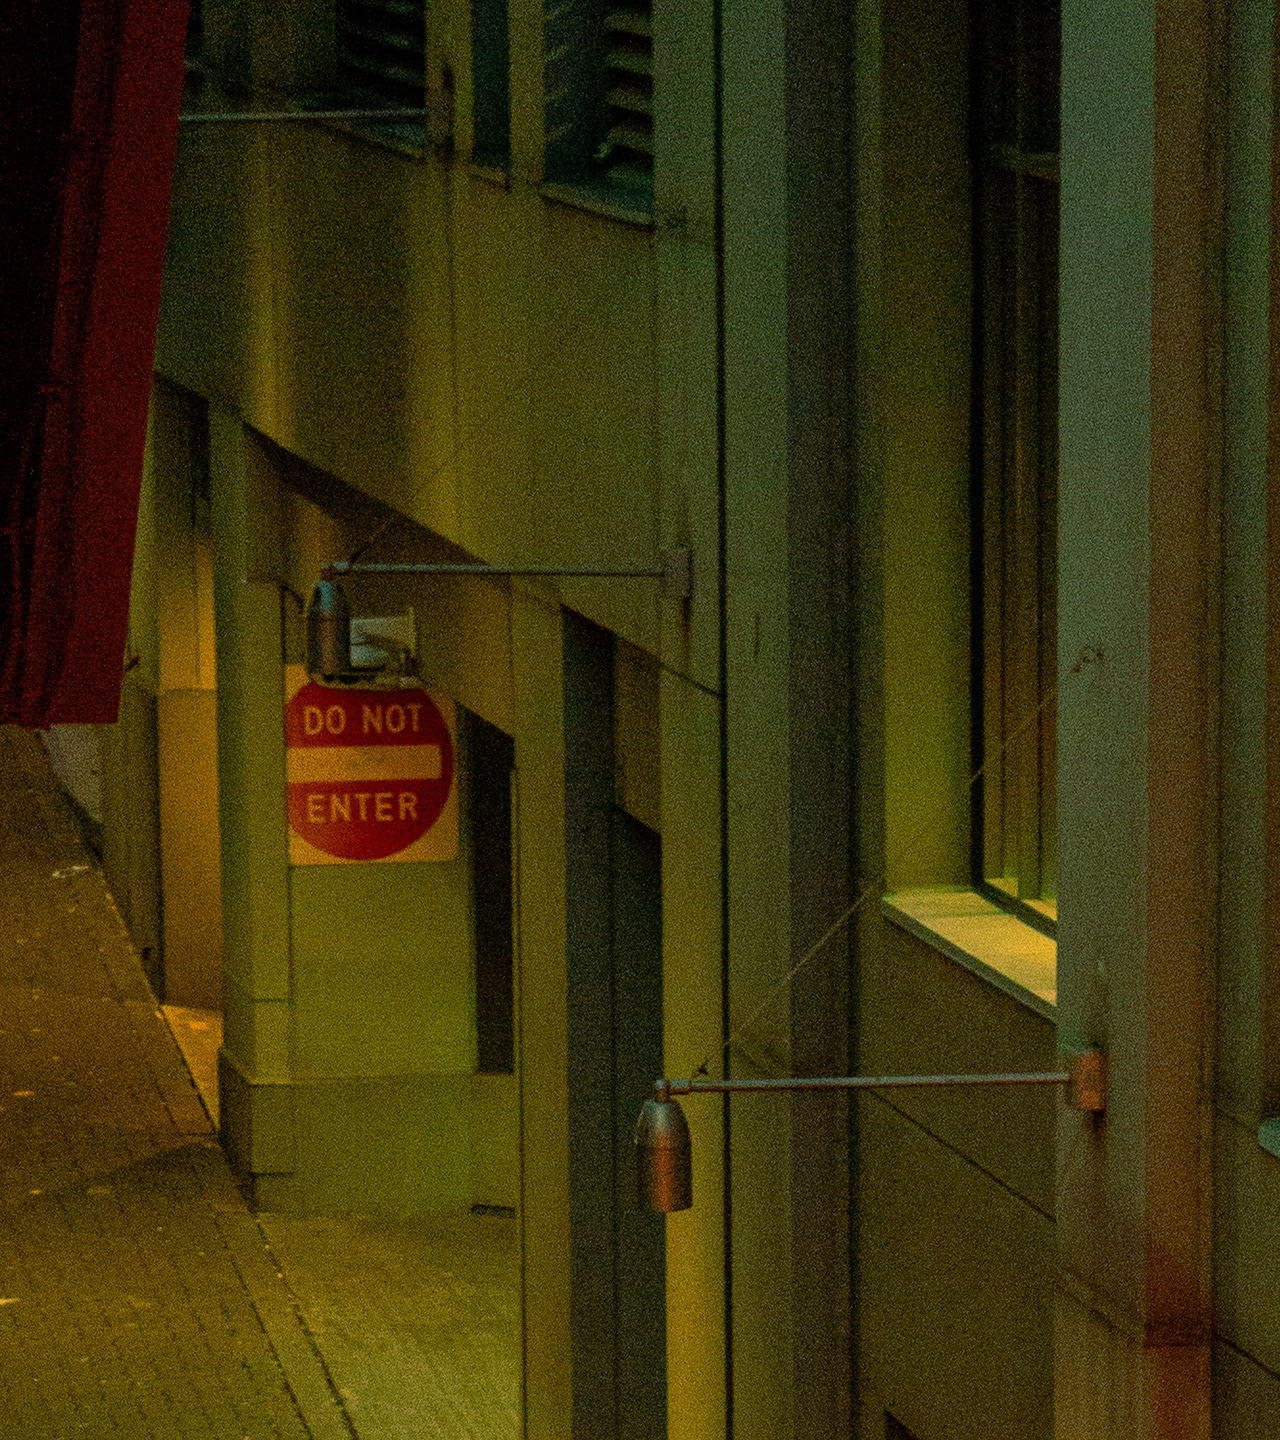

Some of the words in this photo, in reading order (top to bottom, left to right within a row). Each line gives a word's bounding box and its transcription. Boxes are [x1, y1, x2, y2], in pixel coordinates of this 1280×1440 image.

[304, 706, 346, 735] DO
[362, 703, 425, 734] NOT
[307, 793, 420, 824] ENTER
